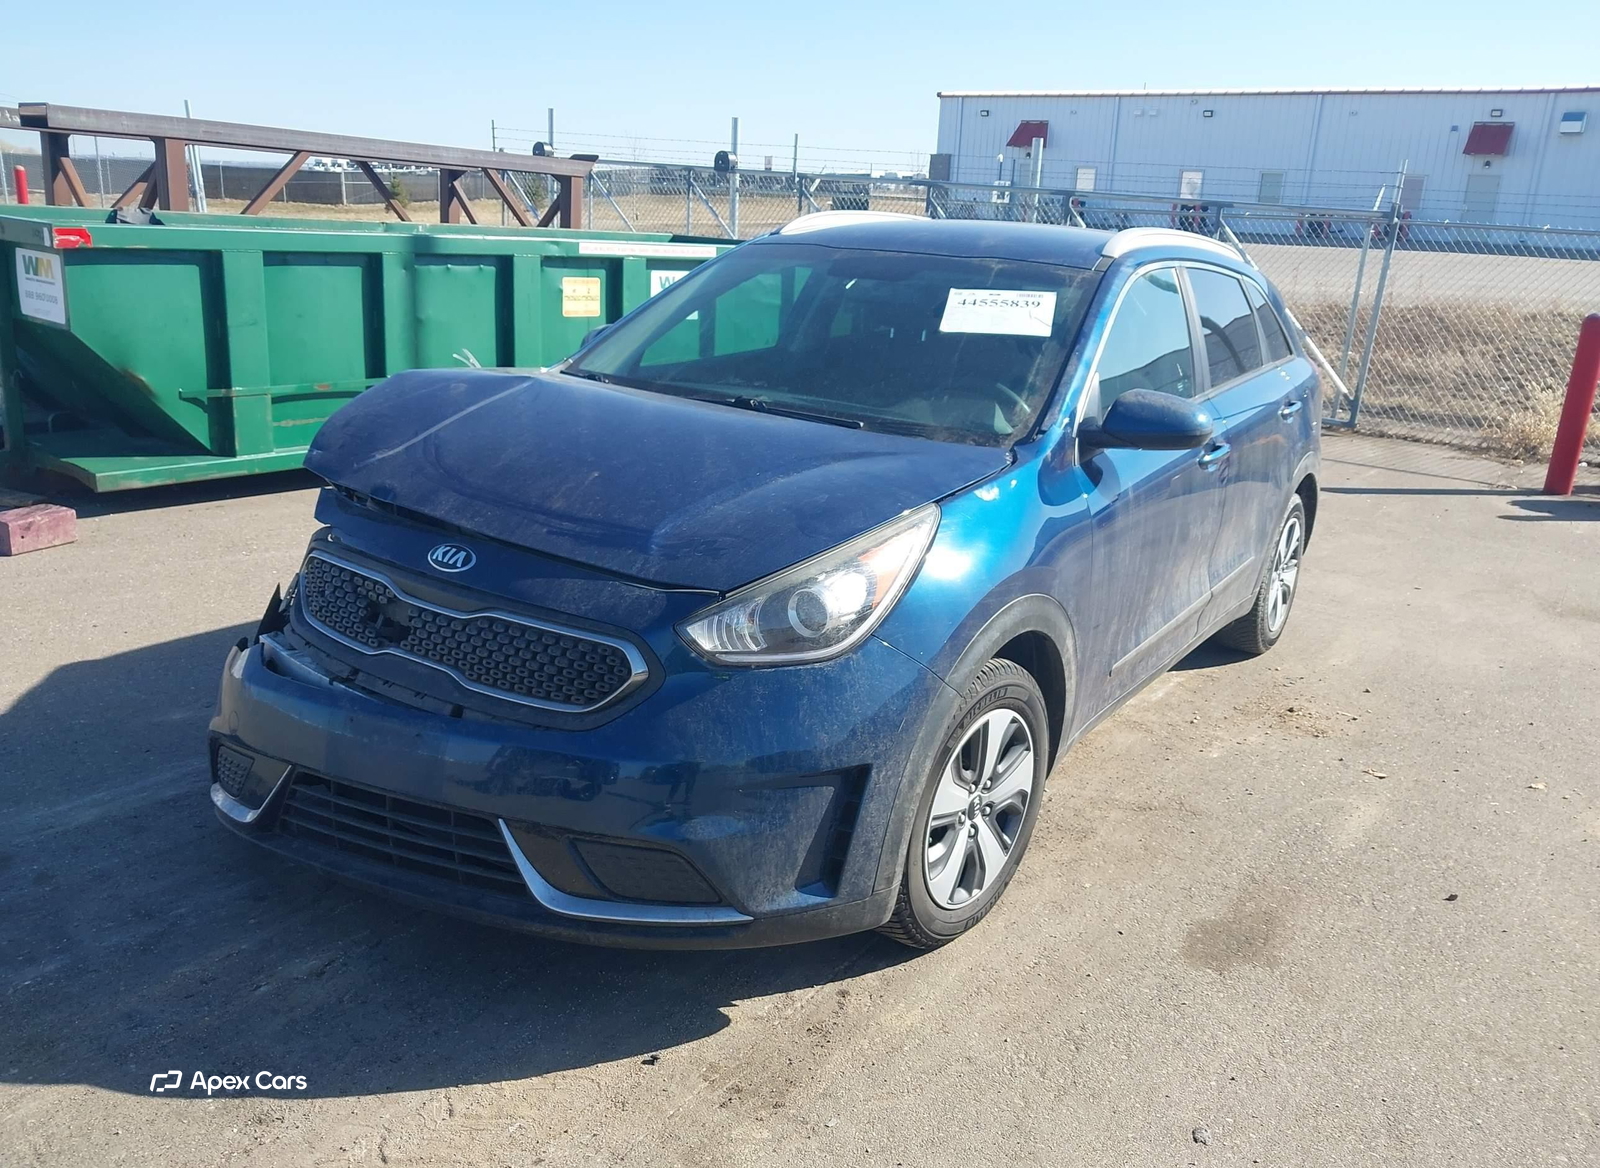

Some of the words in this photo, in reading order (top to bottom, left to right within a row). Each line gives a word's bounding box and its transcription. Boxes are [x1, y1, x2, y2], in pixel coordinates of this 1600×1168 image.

[22, 254, 54, 280] WM
[957, 298, 1041, 308] 44555839
[432, 545, 467, 568] KIA
